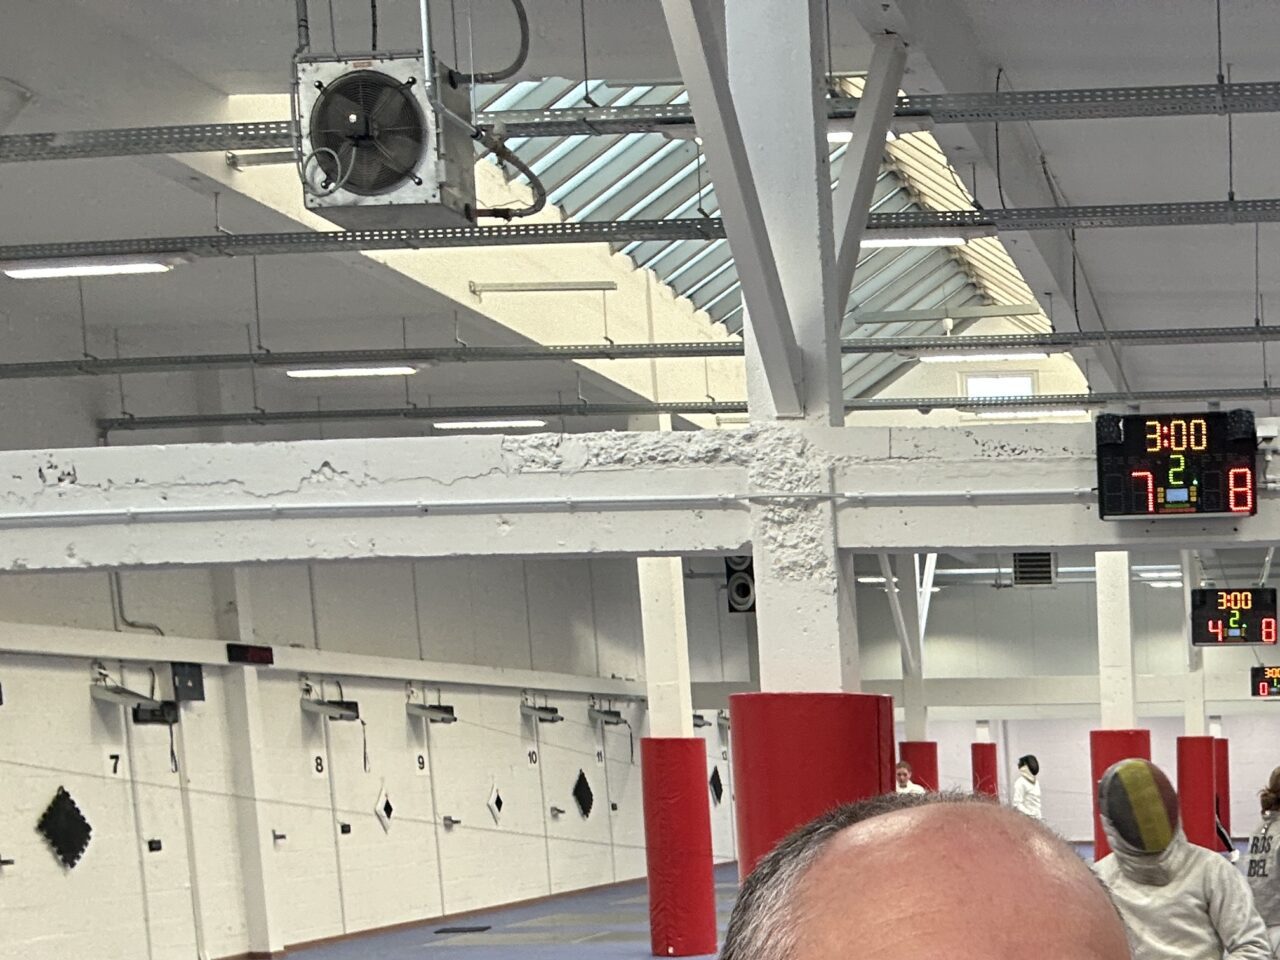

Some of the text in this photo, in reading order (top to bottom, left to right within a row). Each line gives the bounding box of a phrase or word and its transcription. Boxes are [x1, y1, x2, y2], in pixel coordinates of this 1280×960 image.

[1146, 419, 1207, 452] 3:00
[1168, 454, 1185, 485] 2
[1131, 471, 1154, 512] 7
[1229, 467, 1252, 511] 8
[1217, 591, 1252, 610] 3:00
[1229, 610, 1240, 628] 2
[1208, 619, 1223, 642] 4
[1261, 617, 1276, 642] 8
[1259, 682, 1268, 696] 0
[109, 754, 120, 774] 7
[315, 756, 324, 773] 8
[417, 754, 425, 770] 9
[527, 750, 538, 764] 10
[596, 751, 603, 763] 11
[1247, 859, 1268, 877] BEL
